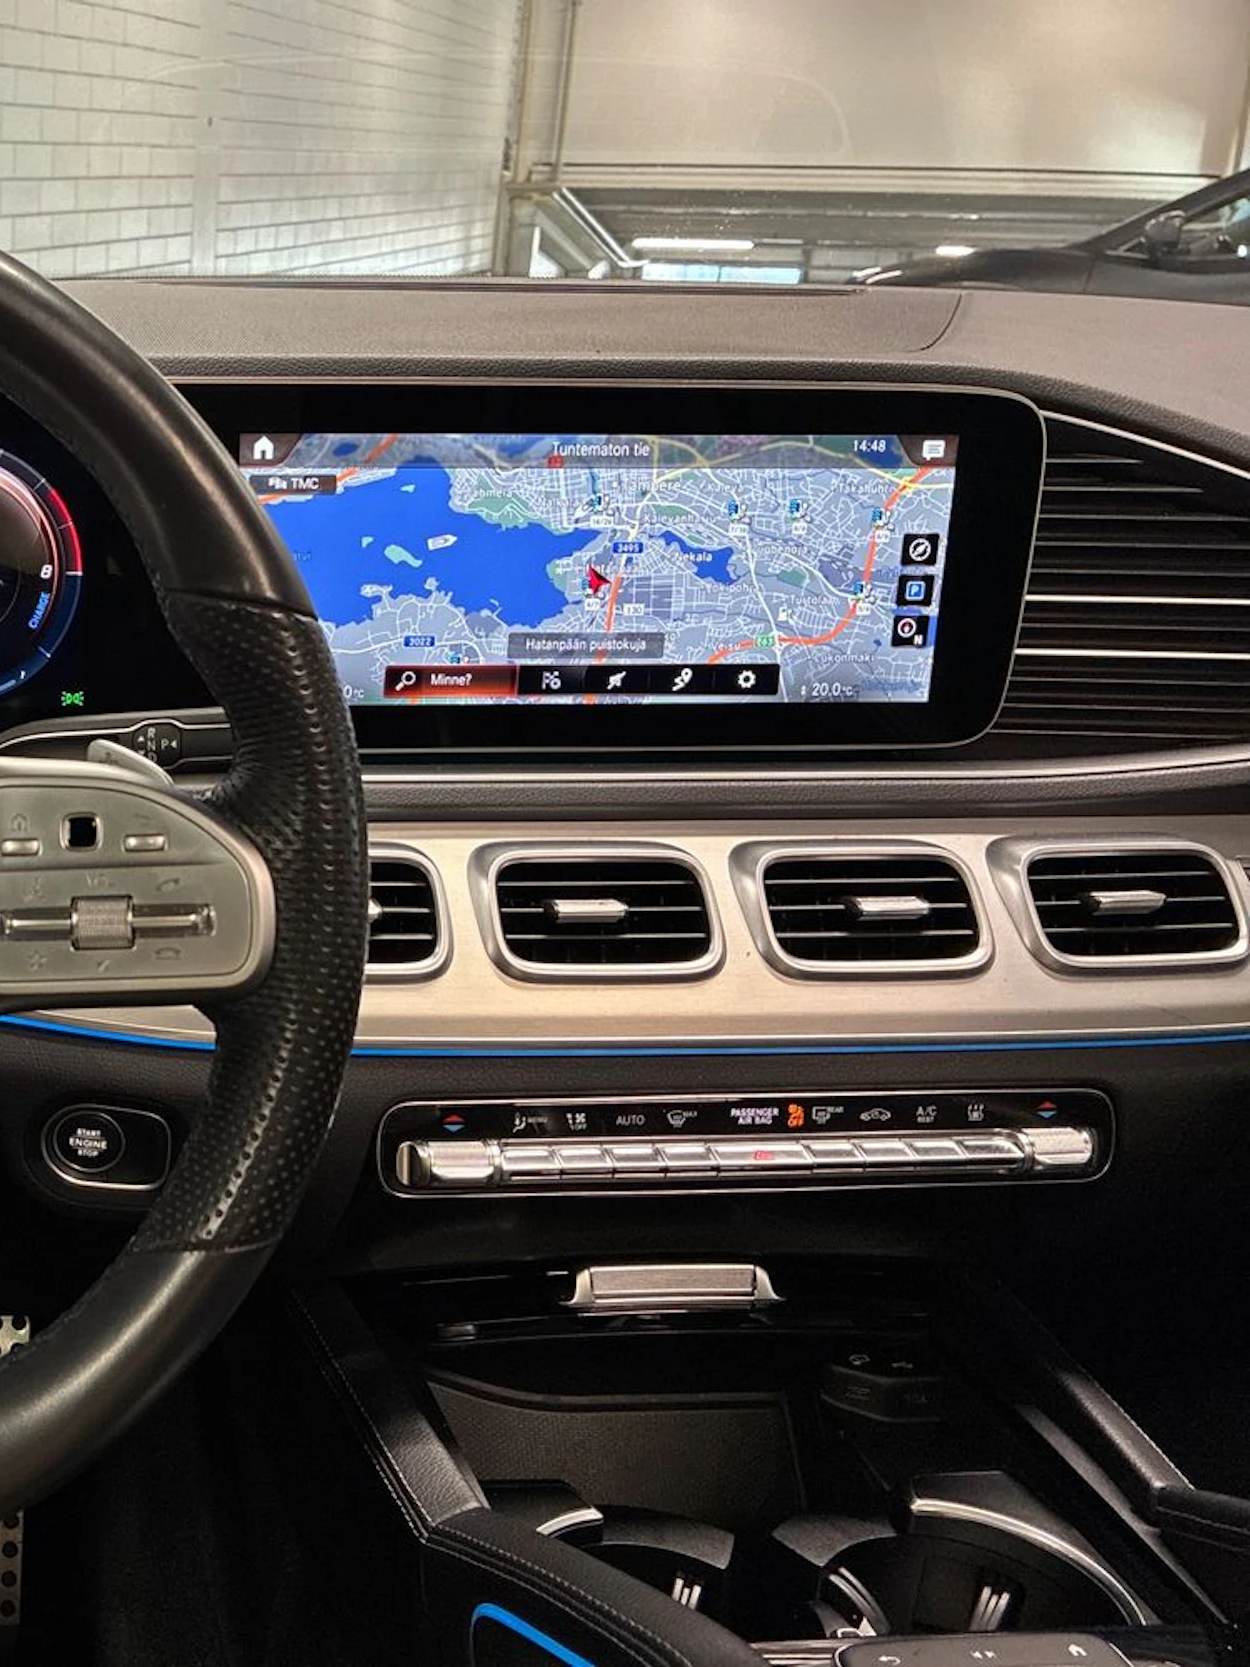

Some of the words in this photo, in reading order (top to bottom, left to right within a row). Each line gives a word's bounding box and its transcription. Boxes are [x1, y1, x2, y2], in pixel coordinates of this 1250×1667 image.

[553, 442, 629, 456] Tuntematon
[632, 442, 651, 457] tie
[853, 440, 886, 453] 14:48
[291, 478, 320, 490] TMC
[629, 481, 682, 492] Tampere
[617, 543, 639, 552] 3495
[674, 553, 713, 563] Nekala
[40, 565, 53, 579] 8
[28, 592, 51, 629] CHARGE
[626, 606, 642, 614] 130
[409, 638, 431, 647] 3022
[526, 639, 586, 652] Hatanpään
[589, 639, 646, 653] puistokuja
[913, 635, 923, 646] N
[430, 672, 471, 686] Minne?
[147, 728, 156, 739] R
[147, 741, 156, 752] N
[161, 739, 169, 750] P
[730, 1107, 780, 1117] PASSENGER
[916, 1105, 938, 1117] A/C
[616, 1114, 646, 1126] AUTO
[738, 1116, 753, 1125] AIR
[754, 1115, 772, 1125] BAG
[76, 1128, 101, 1137] START
[69, 1137, 107, 1150] ENGINE
[78, 1149, 99, 1158] STOP
